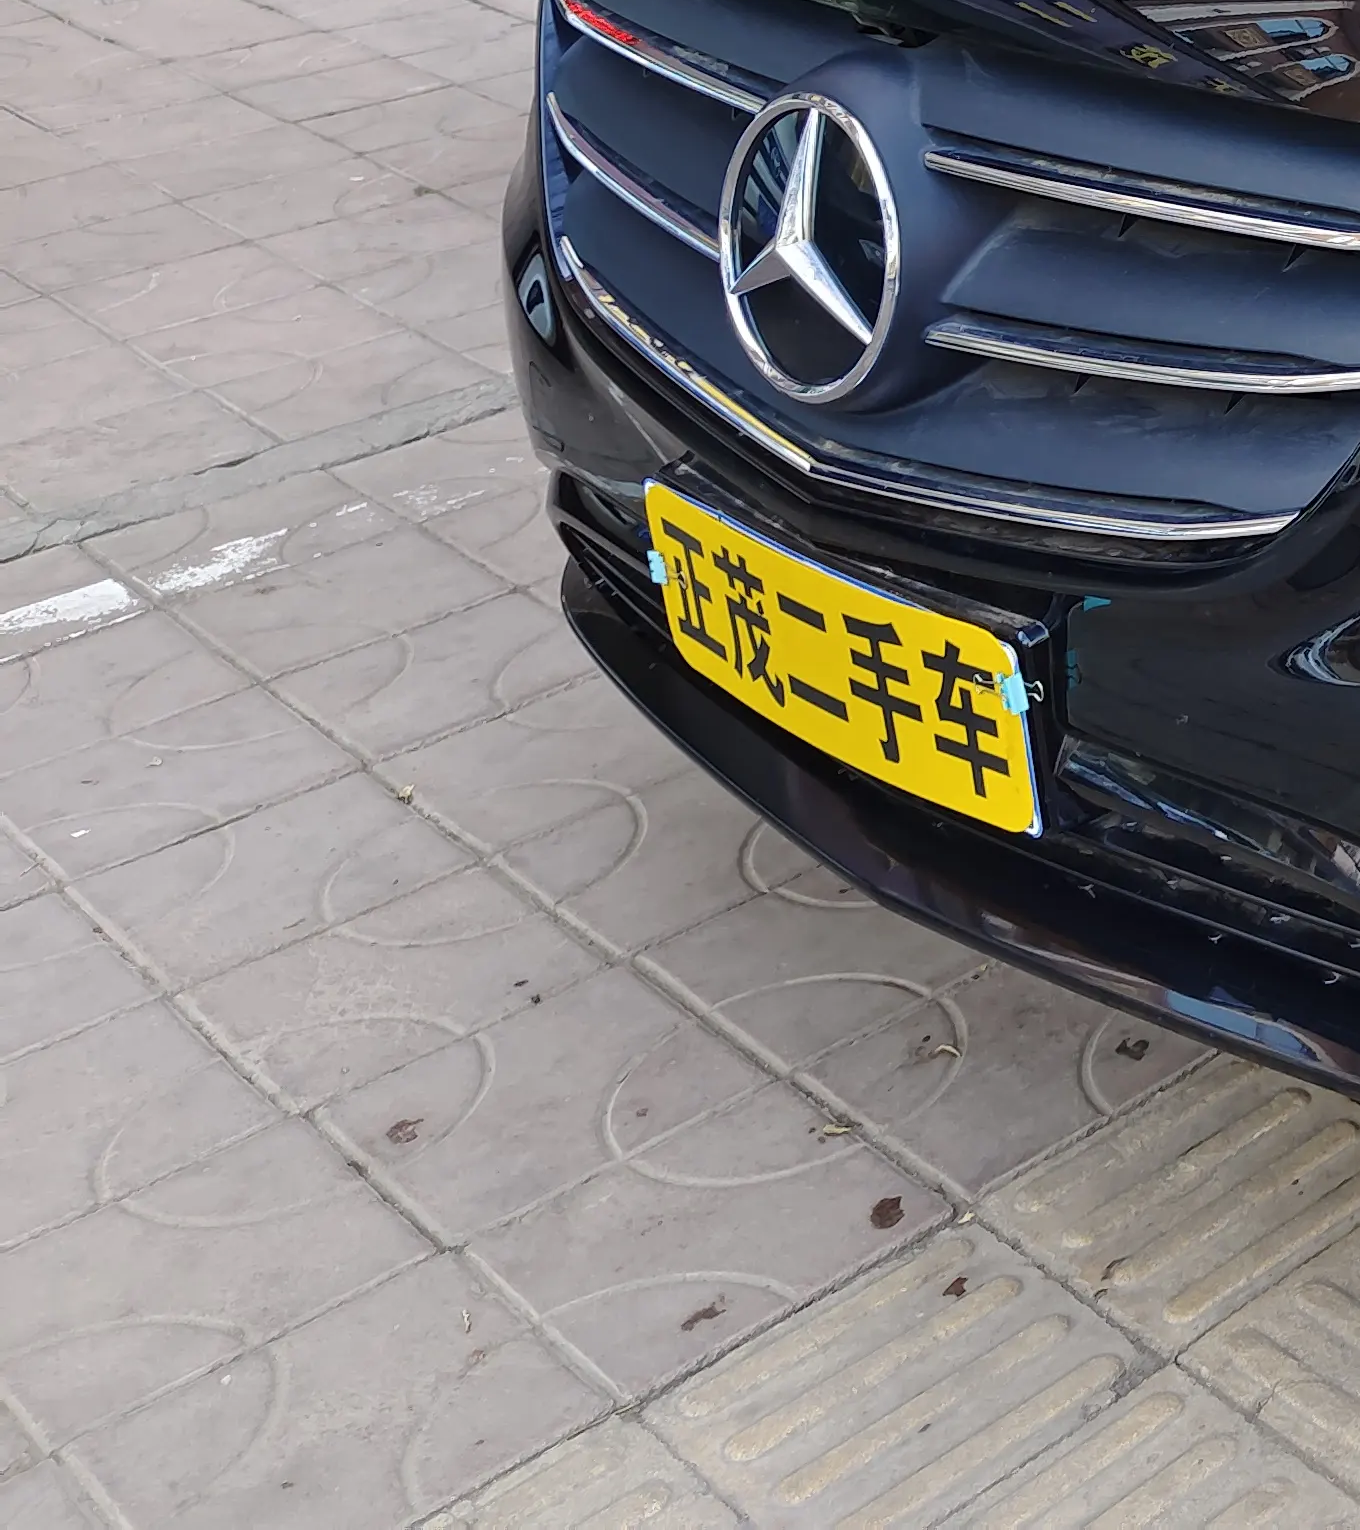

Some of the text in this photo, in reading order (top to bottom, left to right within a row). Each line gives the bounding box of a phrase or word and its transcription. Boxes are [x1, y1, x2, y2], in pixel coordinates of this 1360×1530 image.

[662, 517, 1011, 799] 正茂二手车
